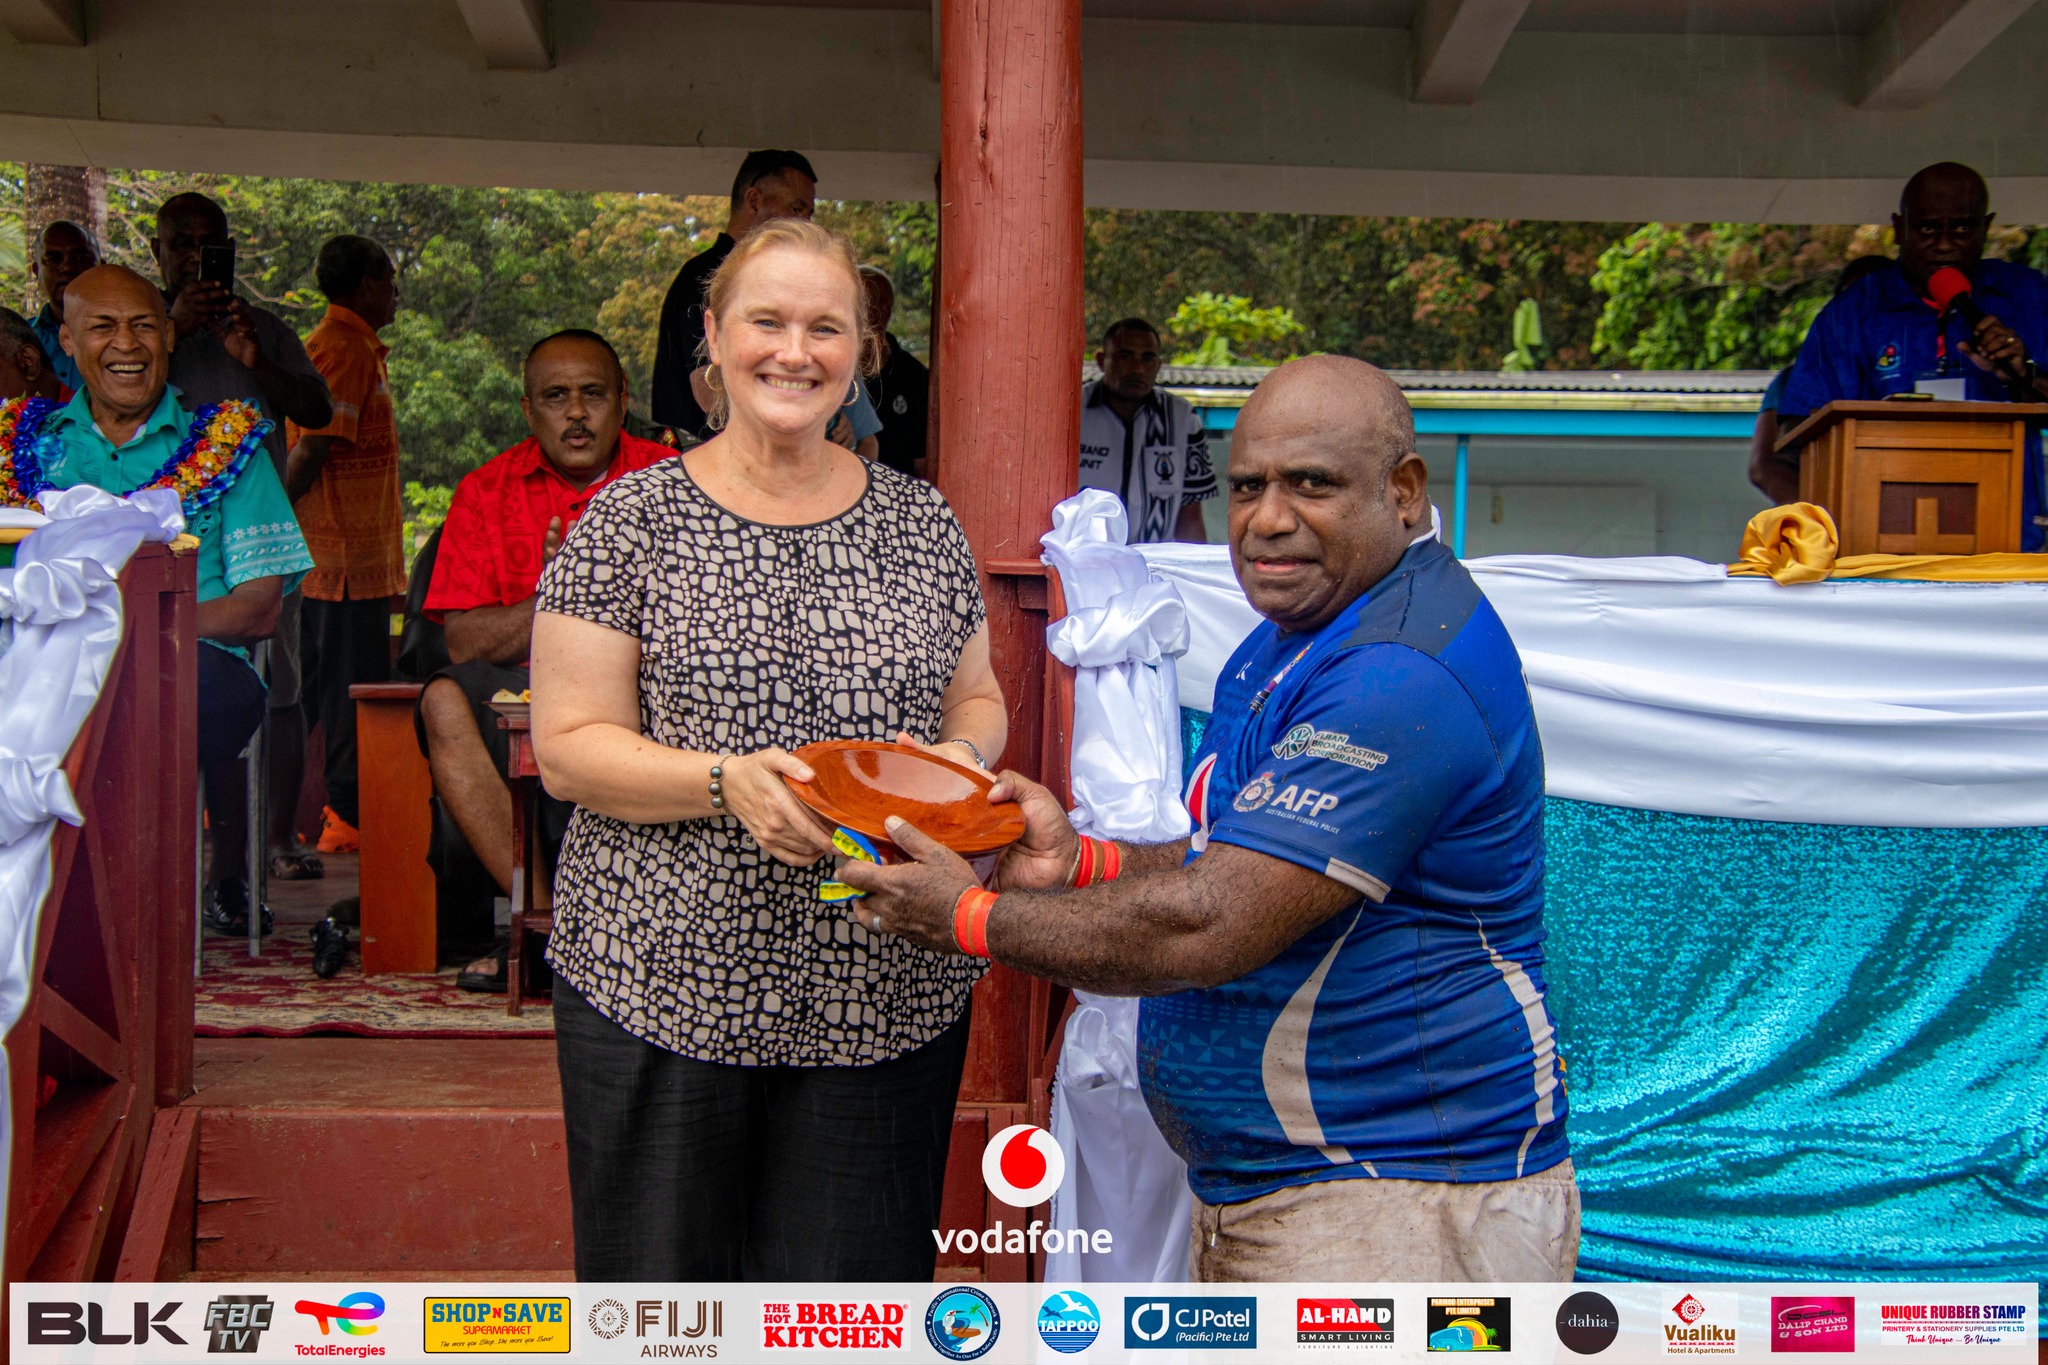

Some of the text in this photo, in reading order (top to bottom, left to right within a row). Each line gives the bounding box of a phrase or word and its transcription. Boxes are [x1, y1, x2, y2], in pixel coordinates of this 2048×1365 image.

[1315, 732, 1348, 743] FIJIAN
[1308, 748, 1375, 769] CORPORATION
[1311, 739, 1386, 763] BROADCASTING
[1271, 784, 1339, 817] AFP
[1265, 808, 1340, 835] AUSTRALIAN FEDERAL POLICE
